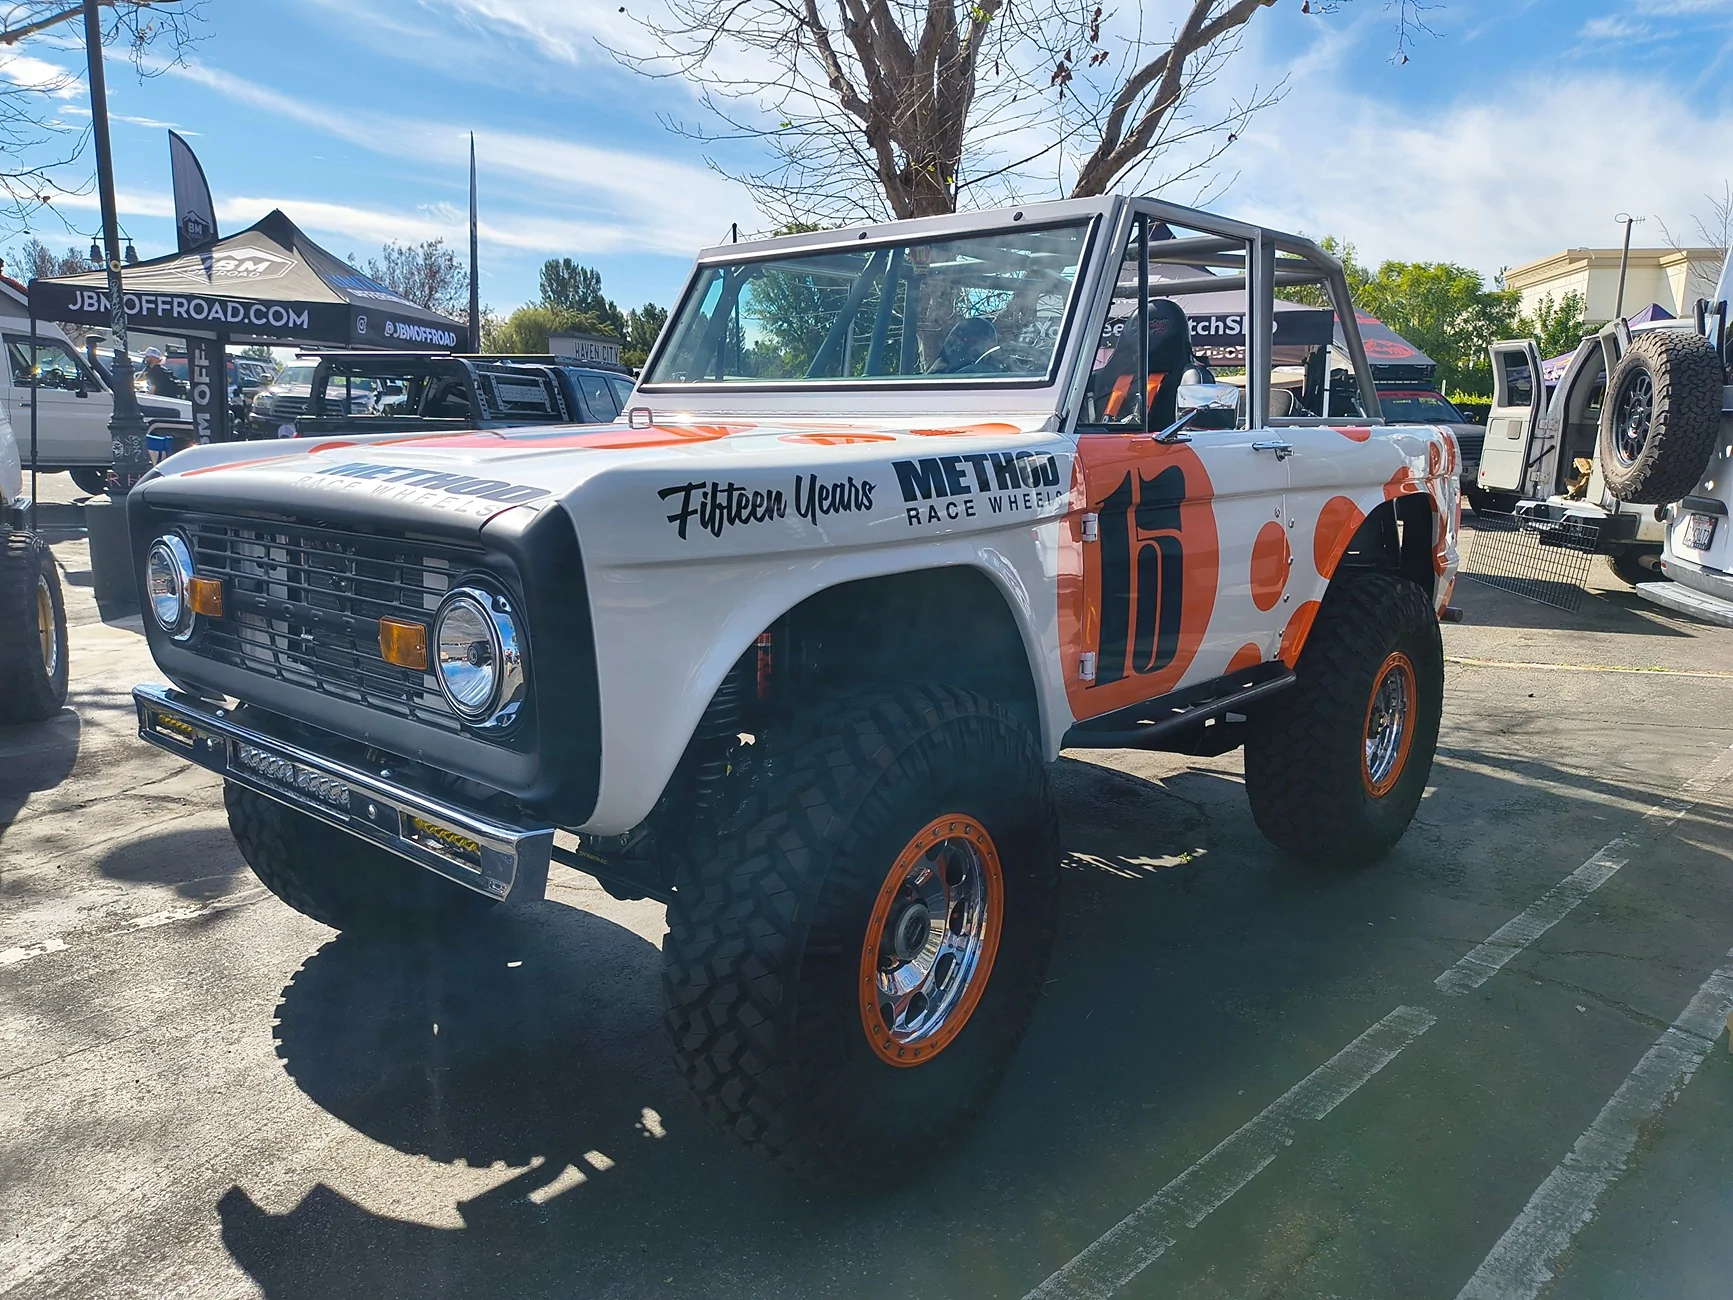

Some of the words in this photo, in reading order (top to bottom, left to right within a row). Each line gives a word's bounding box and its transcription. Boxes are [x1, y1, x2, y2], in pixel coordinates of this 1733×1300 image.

[384, 320, 457, 347] @JBMOFFROAD
[574, 341, 600, 360] HAVEN
[602, 345, 619, 363] CITY
[290, 475, 363, 493] RACE
[370, 484, 500, 517] WHEELS
[317, 462, 552, 504] METHOD
[892, 451, 1060, 502] METHOD
[657, 480, 788, 541] Fifteen
[795, 473, 878, 527] Years
[907, 499, 977, 527] RACE
[1085, 465, 1186, 690] 15
